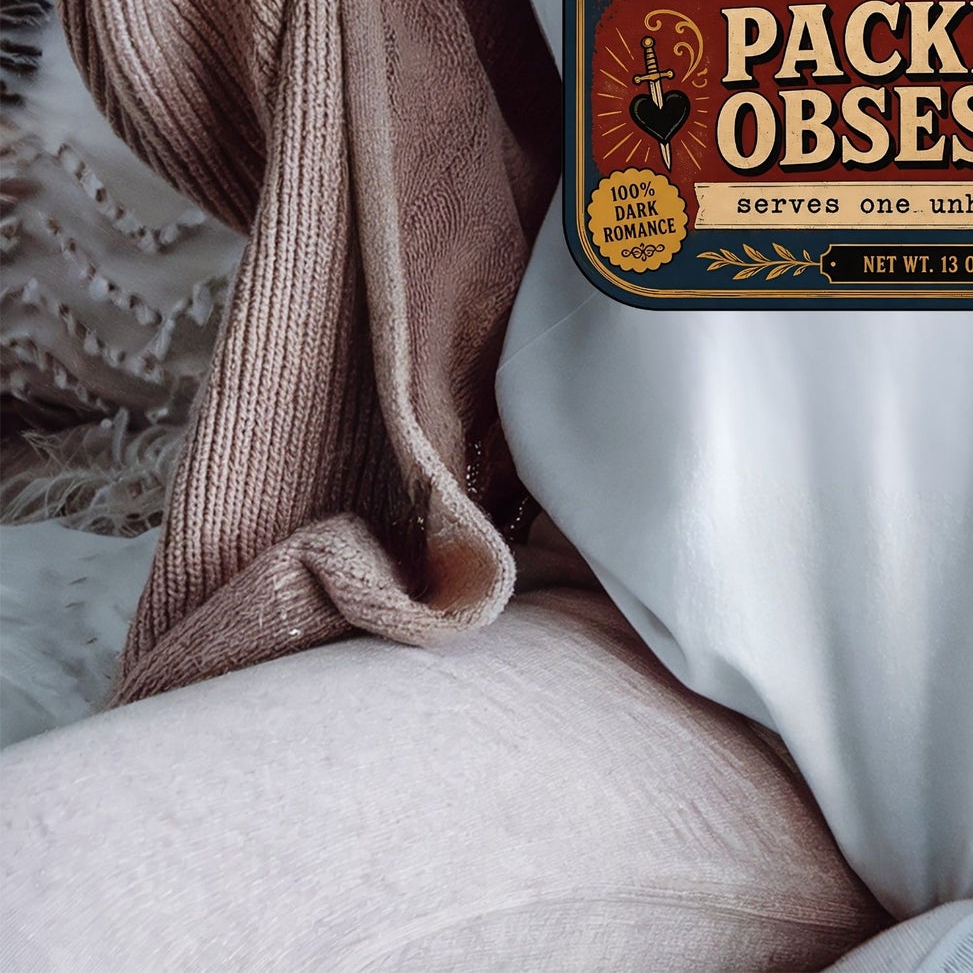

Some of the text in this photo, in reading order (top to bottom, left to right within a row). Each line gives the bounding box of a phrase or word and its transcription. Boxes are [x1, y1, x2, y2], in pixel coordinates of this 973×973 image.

[610, 181, 656, 202] 100%
[614, 202, 659, 222] DARK
[737, 197, 840, 214] serves
[860, 197, 910, 214] one
[603, 218, 676, 244] ROMANCE
[862, 255, 897, 273] NET
[903, 255, 934, 273] WT.
[941, 255, 959, 273] 13
